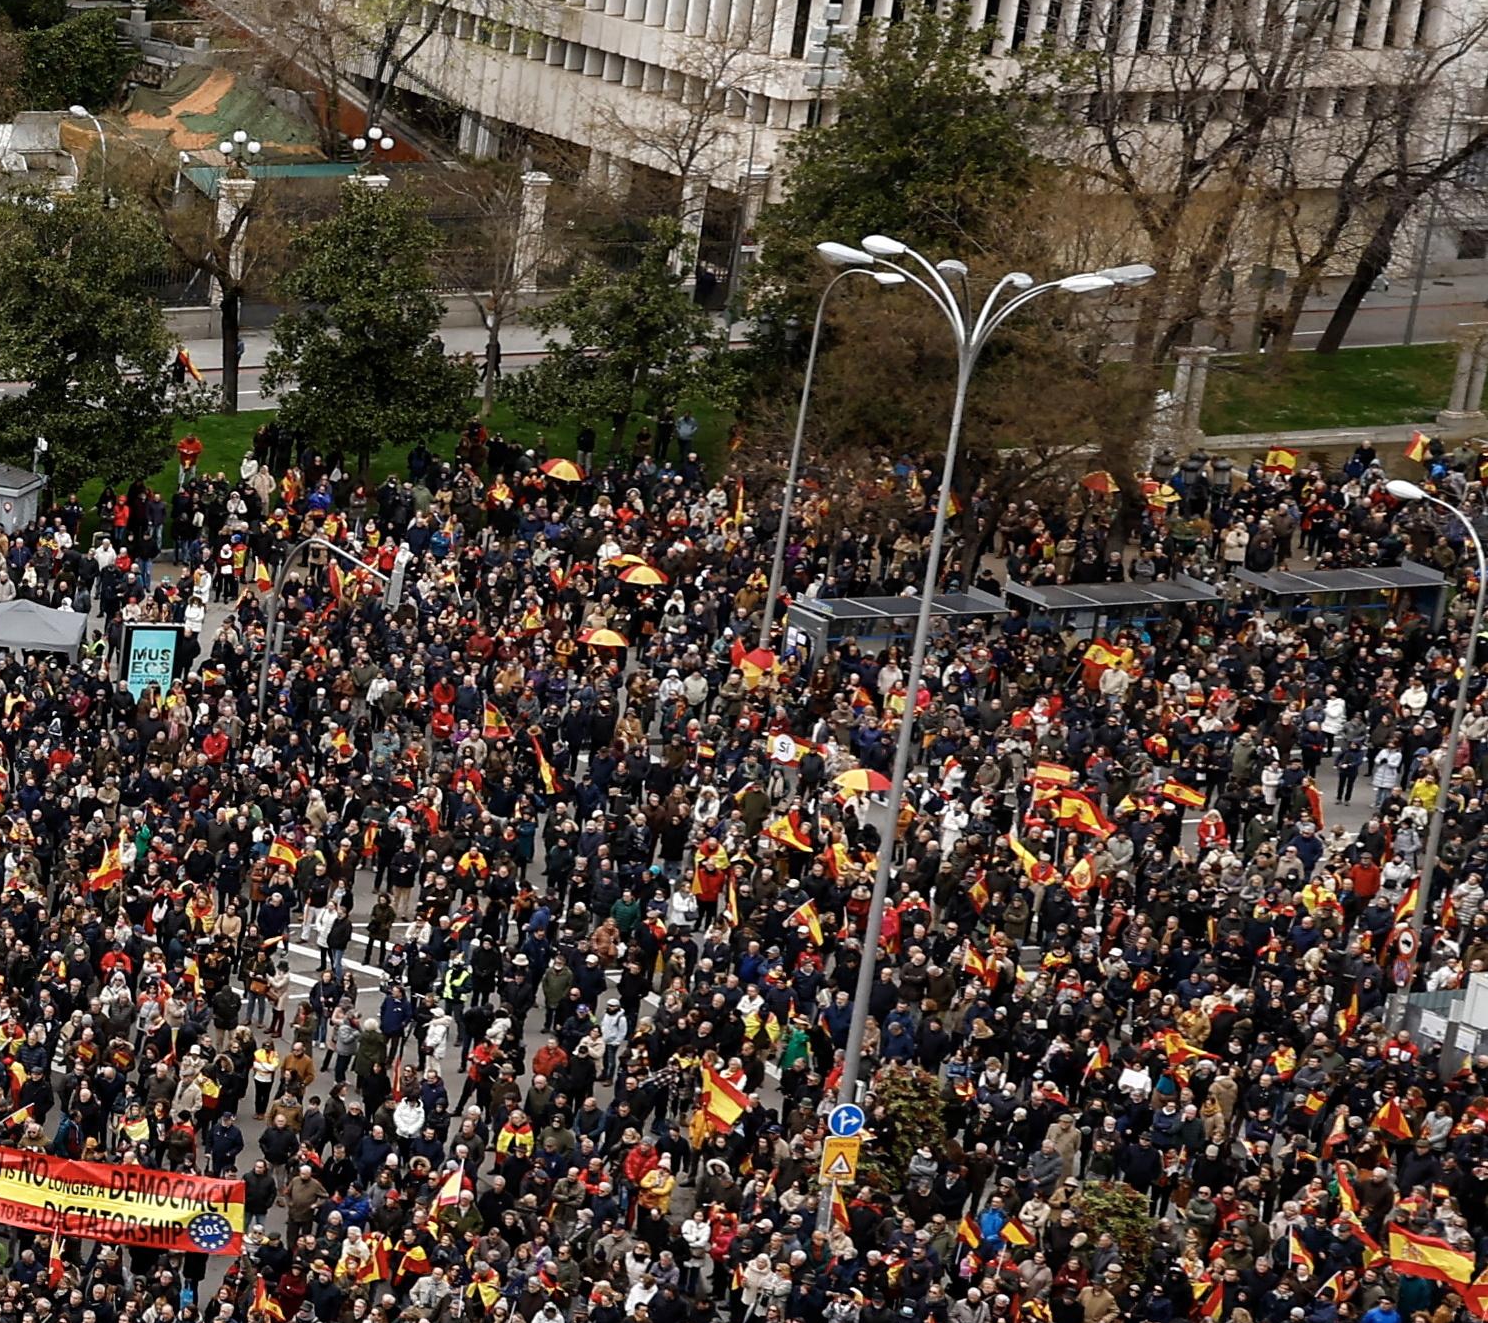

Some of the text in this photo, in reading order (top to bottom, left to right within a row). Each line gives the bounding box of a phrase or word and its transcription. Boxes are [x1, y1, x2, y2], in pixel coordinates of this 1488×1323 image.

[21, 1157, 48, 1187] NO
[48, 1179, 95, 1198] LONGER
[96, 1184, 106, 1199] A
[108, 1170, 234, 1214] DEMOCRACY
[0, 1203, 14, 1219] TO
[40, 1200, 183, 1245] DICTATORSHIP
